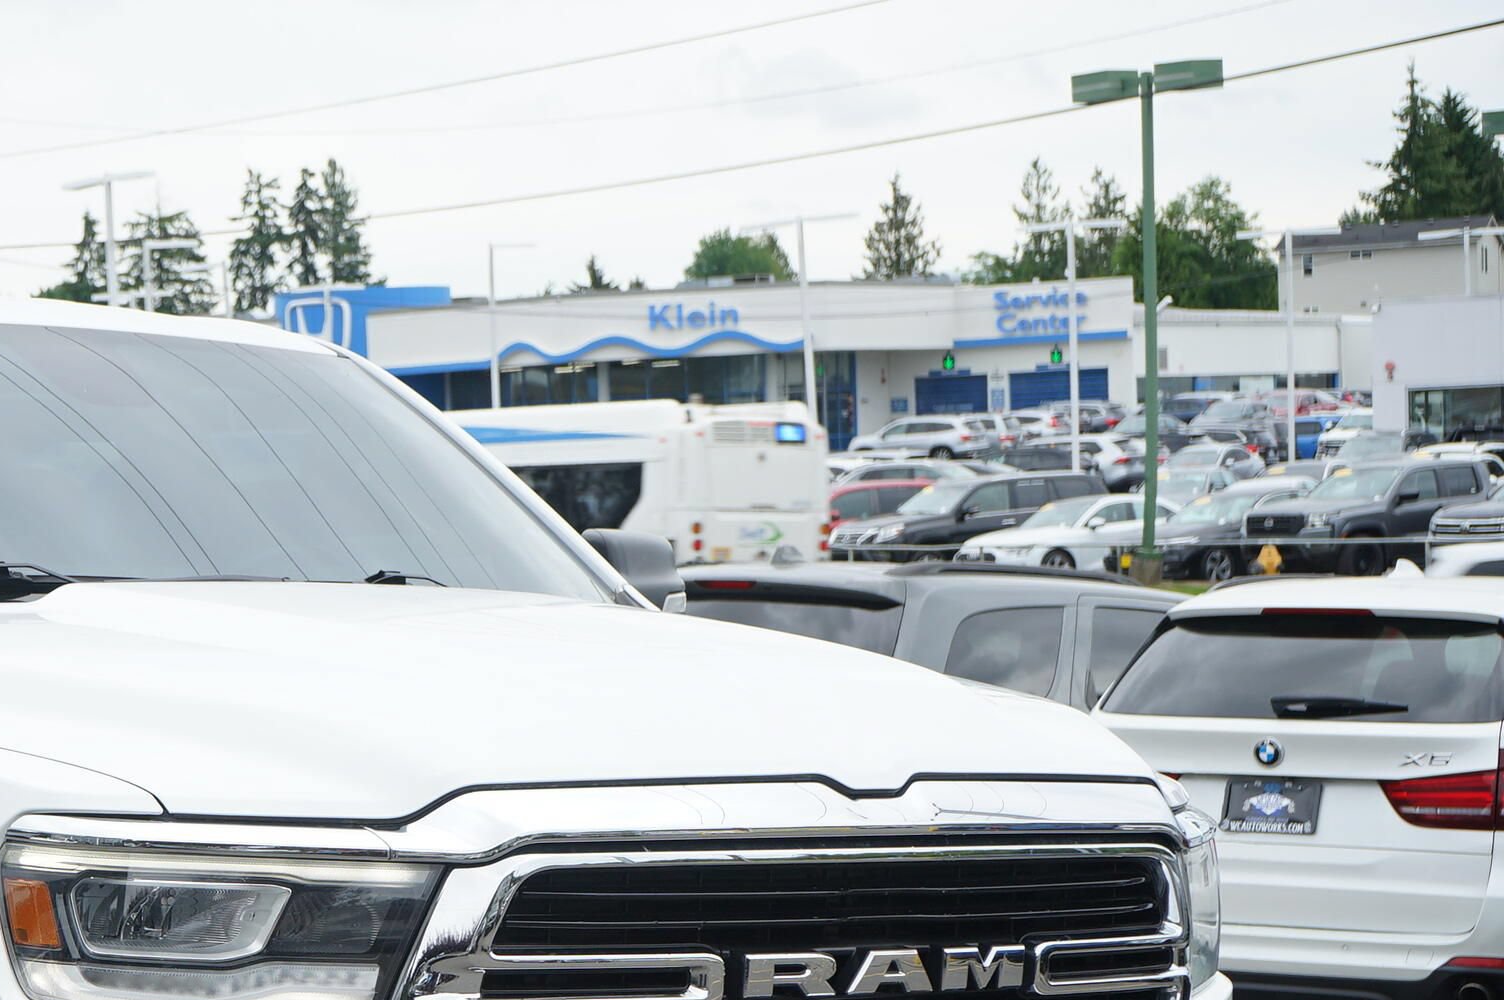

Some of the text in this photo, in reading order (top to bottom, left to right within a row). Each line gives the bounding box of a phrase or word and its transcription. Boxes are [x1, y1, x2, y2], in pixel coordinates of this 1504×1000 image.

[994, 287, 1088, 310] Service
[648, 300, 739, 331] Klein
[996, 312, 1087, 334] Center
[743, 945, 1026, 998] RAM
